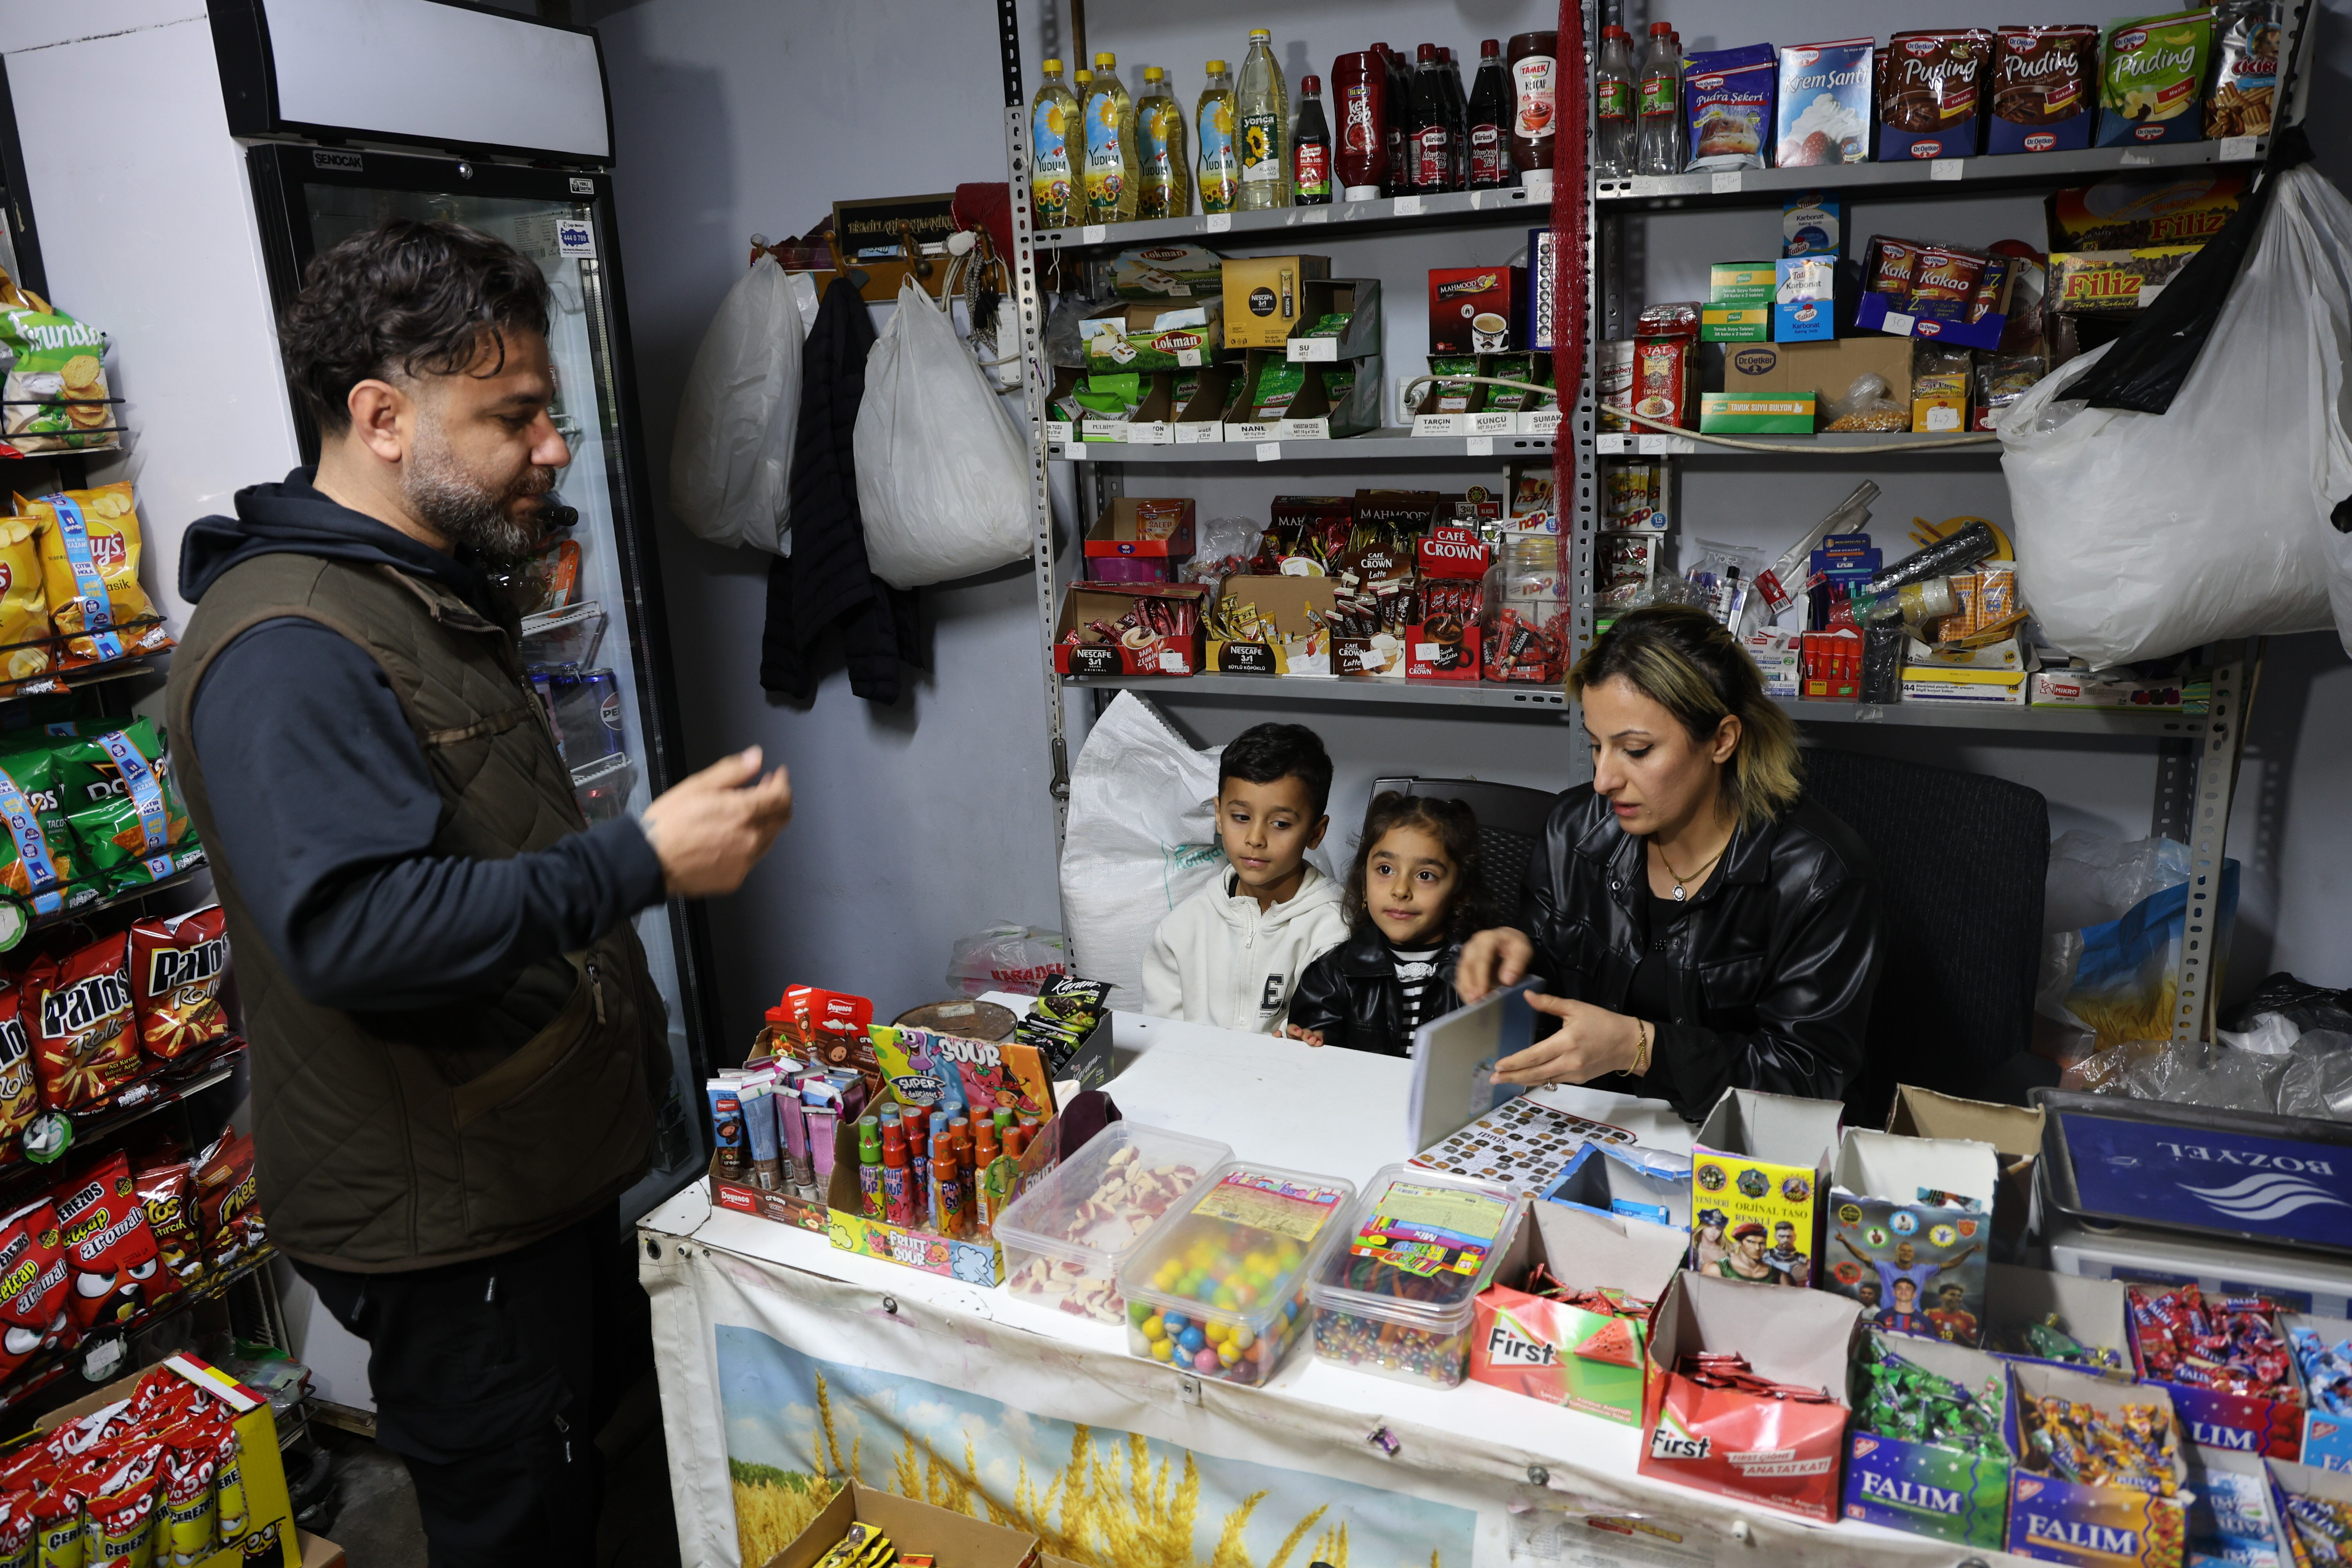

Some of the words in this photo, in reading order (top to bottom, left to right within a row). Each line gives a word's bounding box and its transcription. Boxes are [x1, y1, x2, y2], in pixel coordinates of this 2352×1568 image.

[1521, 64, 1546, 74] TAMEK
[2004, 51, 2078, 81] Puding
[2111, 45, 2196, 83] Puding
[1903, 58, 1978, 85] Puding
[1525, 79, 1547, 90] KETÇAP
[1784, 74, 1826, 93] Krem
[1827, 66, 1869, 89] Şanti
[1599, 89, 1614, 97] ÇETİN
[1644, 86, 1659, 94] ÇETİN
[2055, 87, 2076, 100] Kakaolu
[2169, 85, 2187, 96] Muzlu
[1696, 93, 1728, 107] Pudra
[1731, 91, 1764, 104] Şekeri
[1951, 93, 1971, 105] Kakaolu
[1244, 115, 1275, 128] yonca
[1425, 134, 1445, 143] Bürücek
[1474, 132, 1493, 141] Bürücek
[1088, 144, 1119, 166] YUDUM
[1423, 150, 1447, 161] Mayhoş
[1472, 149, 1497, 159] Mayhoş
[1036, 151, 1066, 172] YUDUM
[1140, 156, 1168, 176] YUDUM
[1436, 160, 1446, 170] Tat
[1483, 158, 1495, 168] Tat
[1635, 180, 1651, 190] 25
[1534, 187, 1551, 198] 60
[2151, 212, 2225, 240] Filiz
[1143, 249, 1184, 259] Lokman
[1786, 281, 1821, 290] Karbonat
[1920, 270, 1969, 290] Kakao
[2064, 272, 2142, 298] Filiz
[1440, 279, 1477, 294] MAHMOOD
[1890, 316, 1906, 327] 30
[1154, 335, 1198, 350] Lokman
[1602, 365, 1632, 377] Aydınbey
[1731, 403, 1749, 412] TAVUK
[1751, 403, 1768, 412] SUYU
[1769, 403, 1792, 412] BULYON
[1477, 415, 1507, 425] KÜNCÜ
[1533, 414, 1562, 423] SUMAK
[1601, 437, 1619, 448] 25
[1645, 437, 1662, 449] 25
[1519, 511, 1546, 532] nazo
[1619, 509, 1651, 529] nazo
[1437, 531, 1466, 542] CAFÉ
[1423, 541, 1482, 561] CROWN
[1361, 559, 1392, 568] CROWN
[1368, 569, 1387, 579] Latte
[1138, 647, 1153, 657] DAHA
[1339, 648, 1366, 657] CROWN
[1439, 646, 1453, 655] Sıcak
[1137, 652, 1158, 667] ZENGİN
[1433, 652, 1458, 666] Çikolata
[1144, 661, 1157, 671] TAT
[2055, 686, 2078, 695] MİKRO
[133, 780, 156, 793] KAZAN!
[142, 800, 159, 809] ÇITIR
[143, 806, 160, 815] MOLA
[46, 819, 64, 828] TACO
[1051, 980, 1100, 995] Karam
[1260, 974, 1286, 1011] E
[827, 1003, 853, 1017] Doyunca
[67, 1018, 123, 1057] Rolls
[938, 1038, 1002, 1067] SOUR
[898, 1077, 936, 1089] SUPER
[908, 1089, 938, 1099] delicious
[721, 1190, 750, 1205] Doyunca
[765, 1194, 786, 1206] cream
[1695, 1195, 1713, 1208] YENİ
[1714, 1196, 1730, 1208] SERİ
[1735, 1201, 1779, 1216] ORJİNAL
[1782, 1208, 1808, 1219] TASO
[1735, 1212, 1771, 1226] RENKLİ
[80, 1207, 143, 1261] aromalı
[1414, 1230, 1438, 1242] Mix
[889, 1230, 927, 1254] FRUIT
[894, 1246, 926, 1267] SOUR
[16, 1259, 67, 1314] aromalı
[1488, 1327, 1555, 1366] First
[1651, 1429, 1711, 1459] First
[1776, 1465, 1796, 1473] TAT
[1861, 1470, 1962, 1514] FALIM
[2027, 1512, 2138, 1557] FALIM
